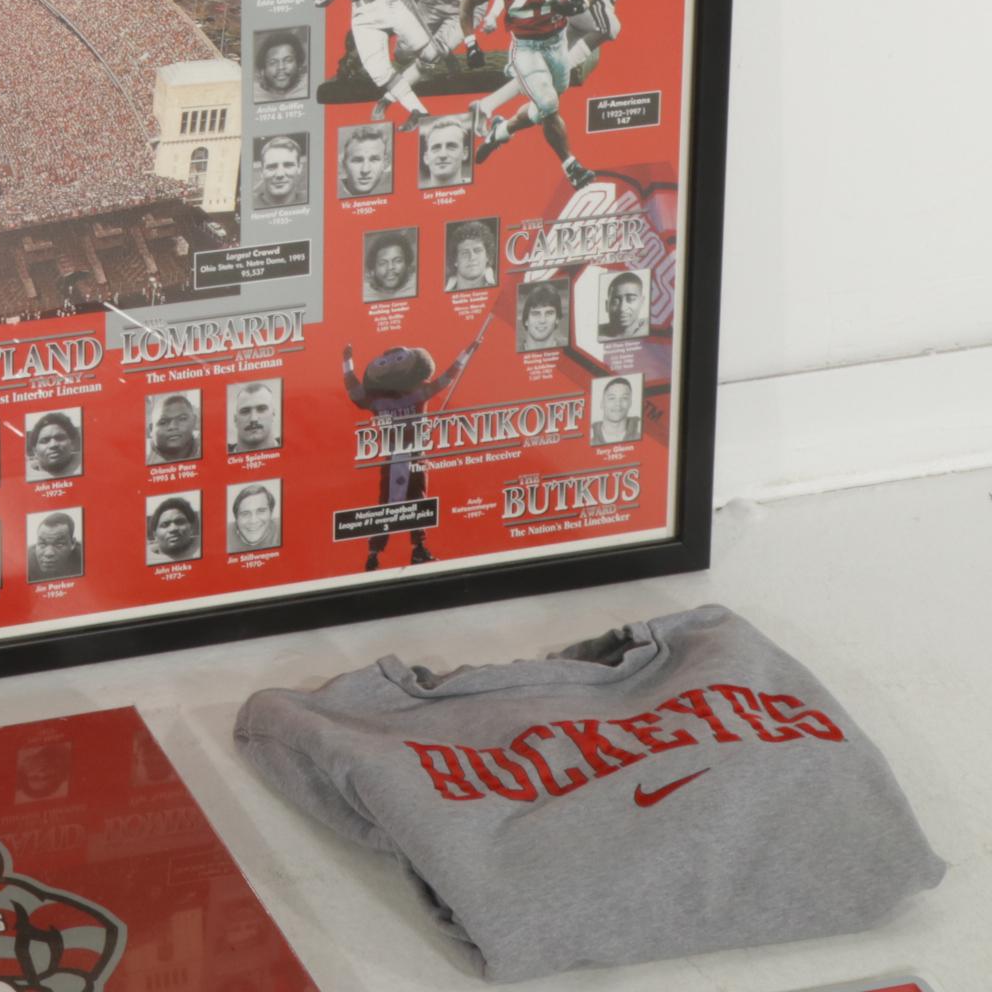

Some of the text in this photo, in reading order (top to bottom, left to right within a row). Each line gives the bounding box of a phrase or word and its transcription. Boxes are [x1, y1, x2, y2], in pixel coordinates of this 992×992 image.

[598, 97, 651, 109] All-Americans
[617, 117, 630, 125] 147
[253, 247, 280, 257] Crowd
[506, 219, 644, 264] CAREER
[201, 265, 216, 273] Ohio
[121, 310, 306, 364] LOMBARDI
[146, 359, 283, 384] The Nation's Best Lineman
[13, 389, 53, 402] Interior
[56, 383, 102, 396] Lineman
[354, 399, 585, 461] BILETNIKOFF
[411, 451, 520, 473] The Nation's Best Receiver
[502, 469, 640, 519] BUTKUS
[339, 521, 362, 530] League
[375, 516, 397, 524] overall
[400, 513, 415, 521] draft
[417, 510, 434, 519] picks
[356, 505, 417, 519] National Football
[510, 513, 630, 538] The Nation's Best Linebacker
[404, 684, 847, 802] BUCKEYES
